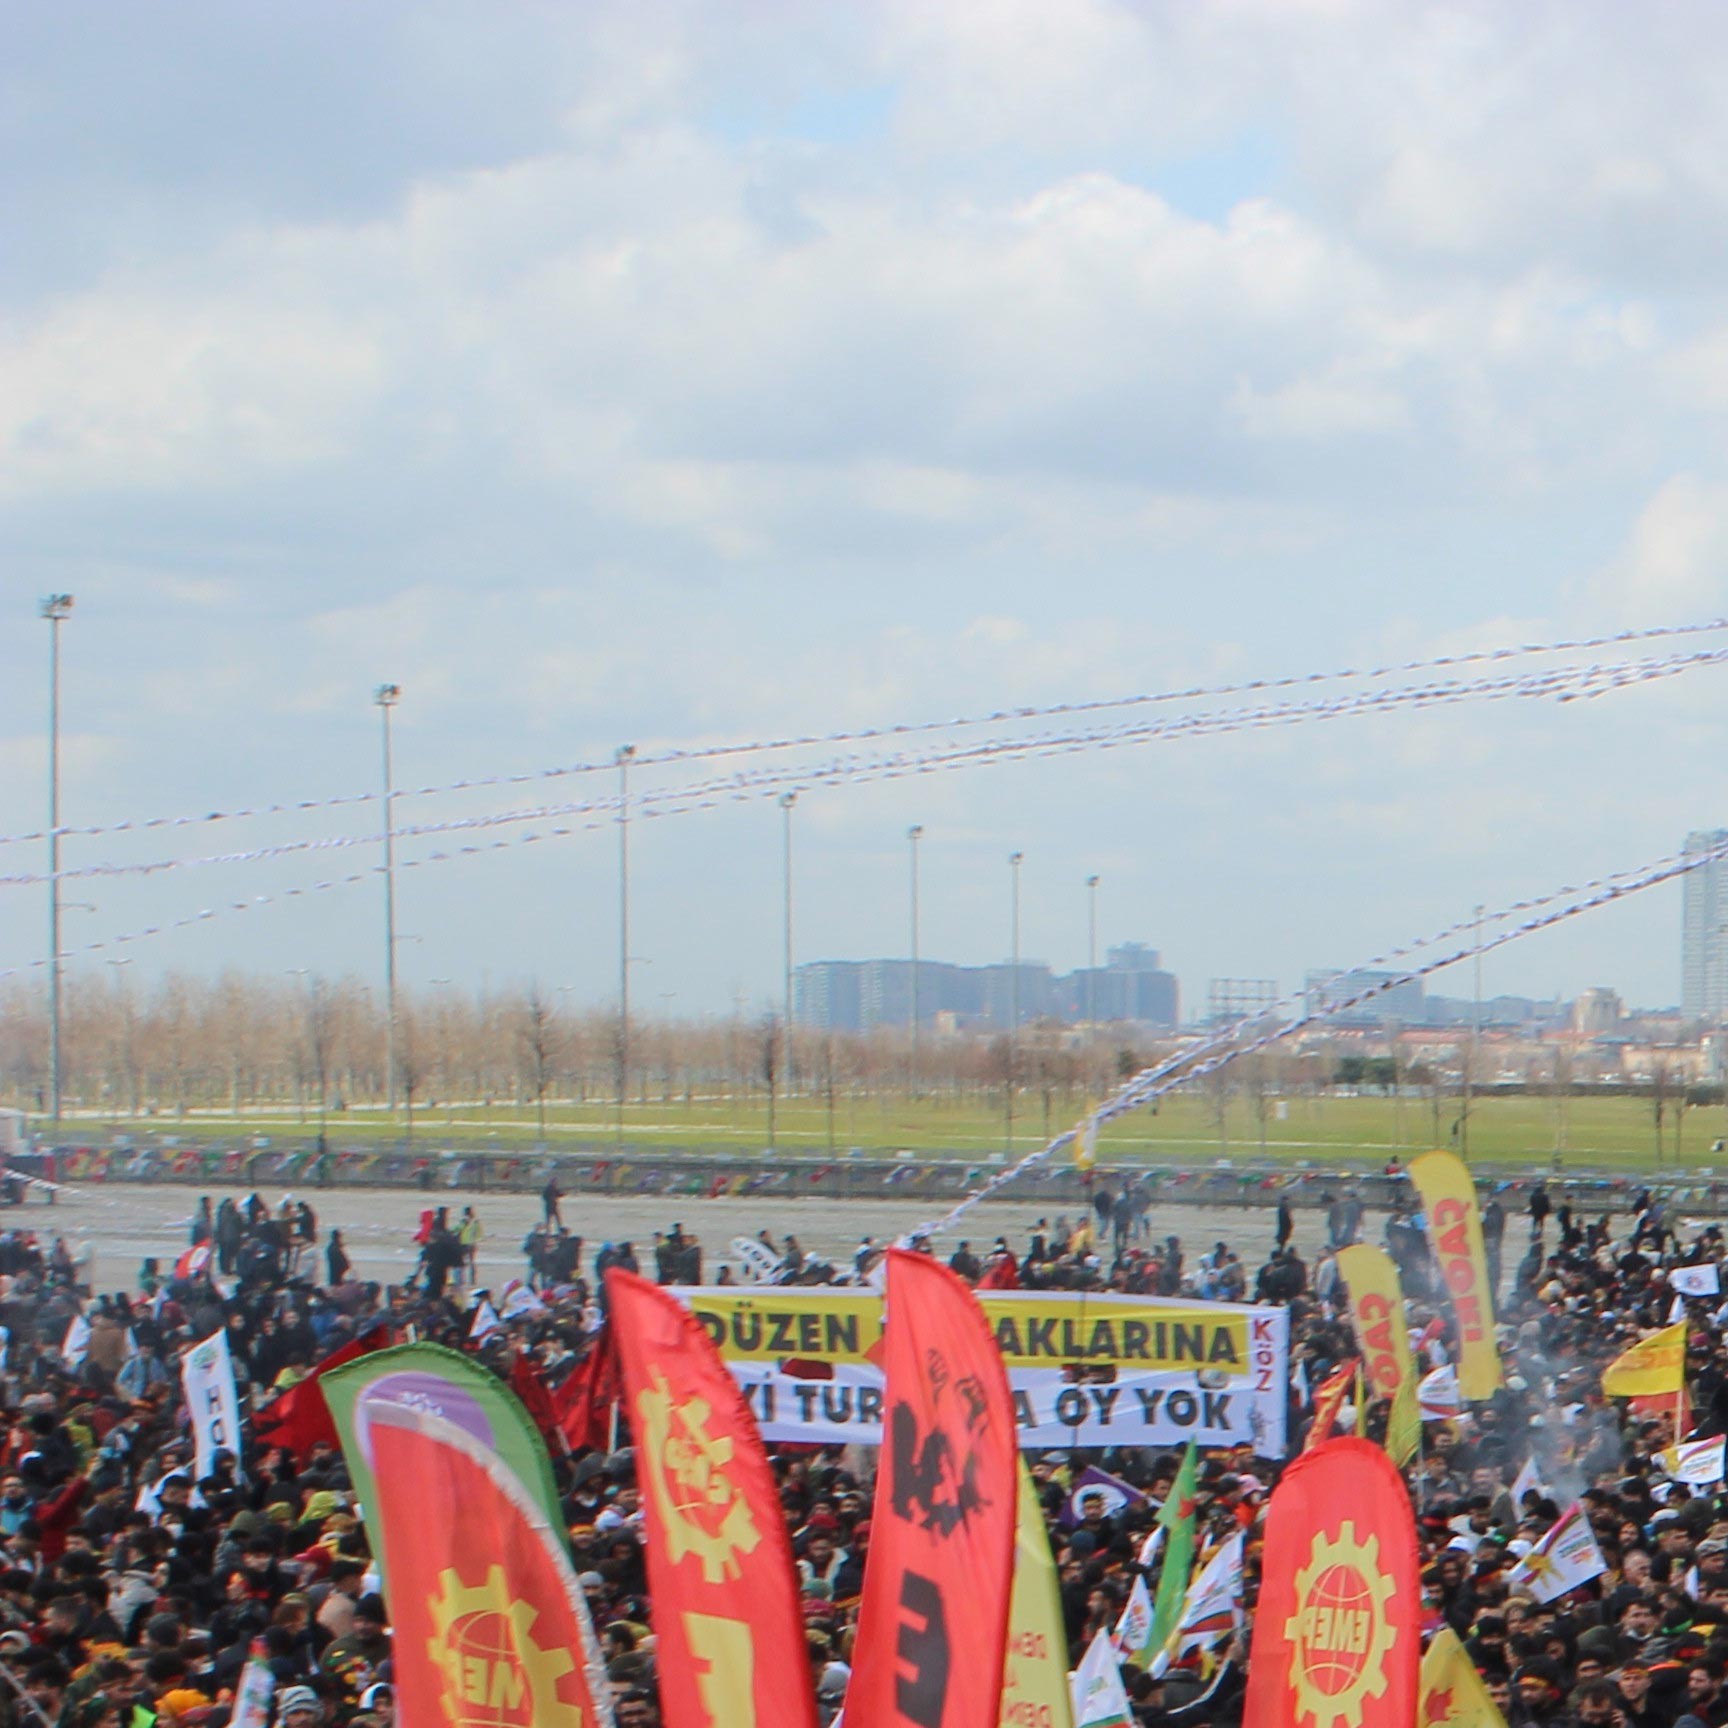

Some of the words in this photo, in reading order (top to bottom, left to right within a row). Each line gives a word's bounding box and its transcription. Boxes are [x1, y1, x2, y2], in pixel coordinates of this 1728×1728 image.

[699, 1303, 858, 1352] DÜZEN
[1000, 1314, 1240, 1364] AKLARINA
[795, 1386, 884, 1424] TUR
[1054, 1386, 1119, 1429] OY
[1131, 1386, 1233, 1432] YOK
